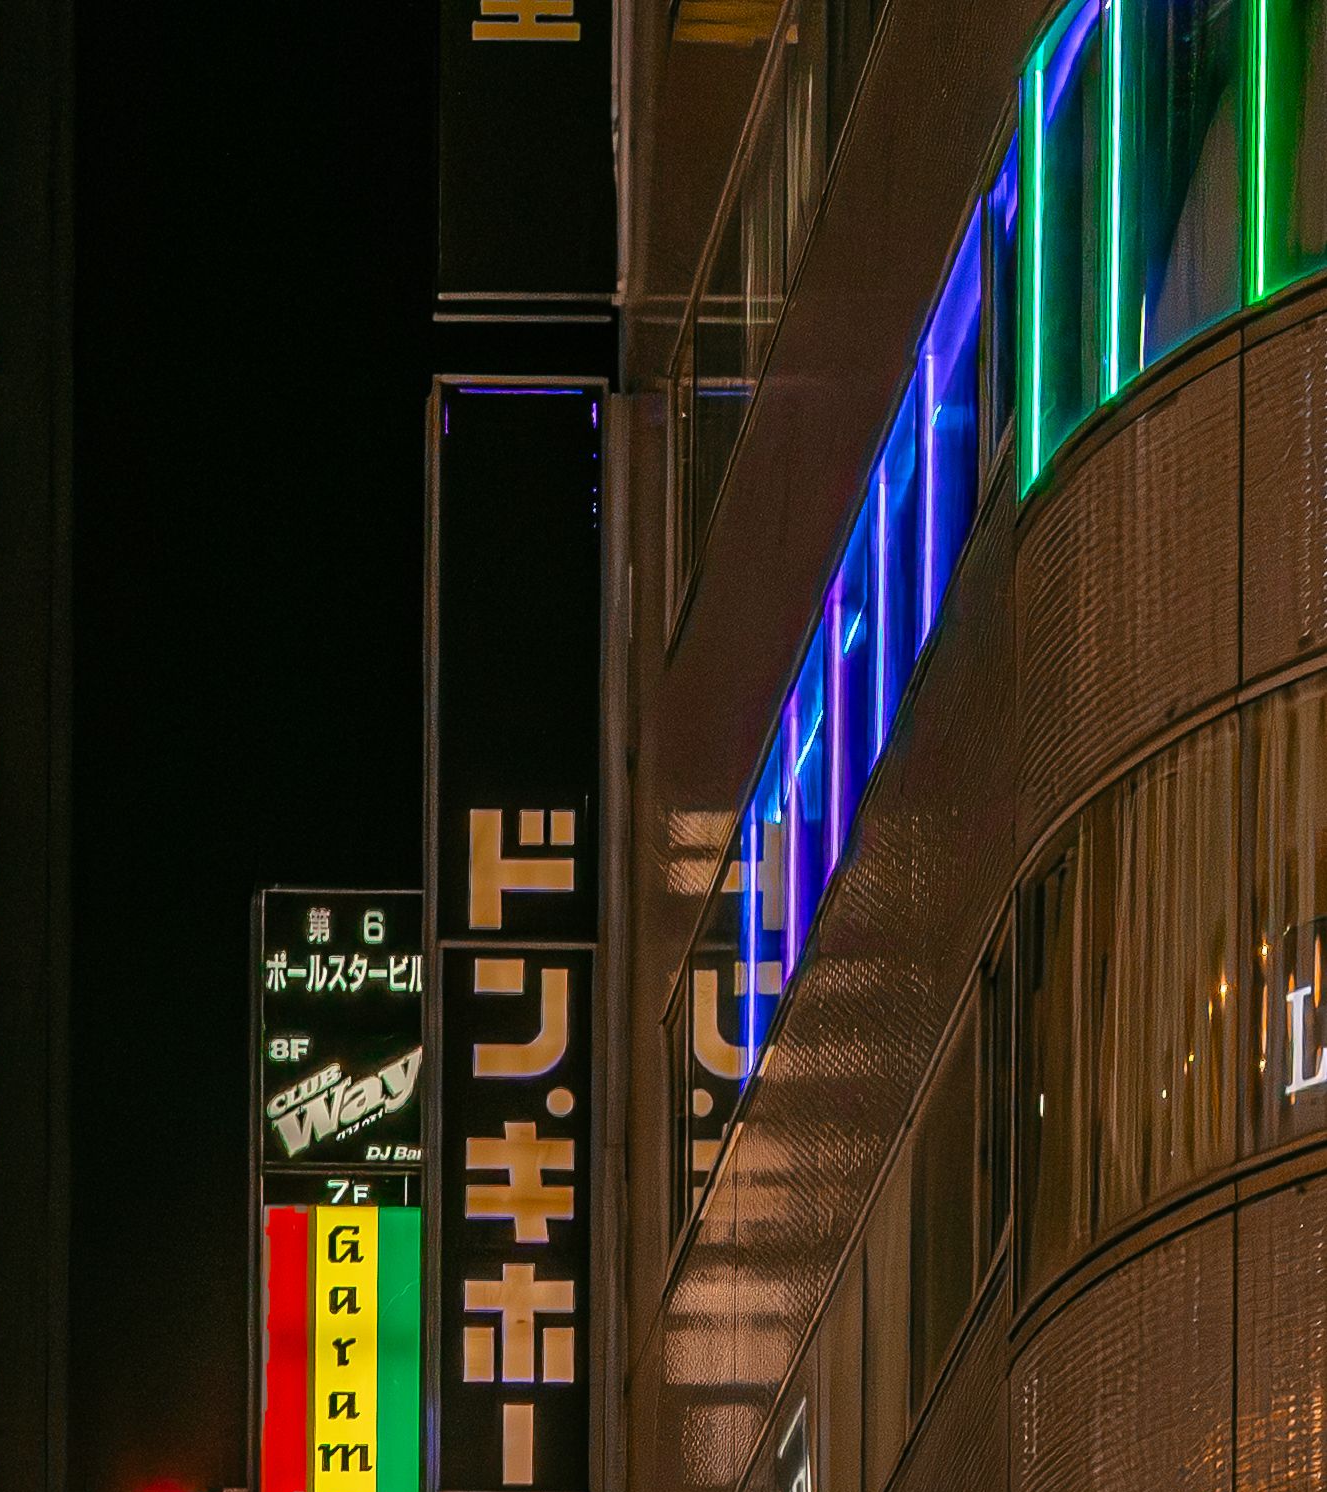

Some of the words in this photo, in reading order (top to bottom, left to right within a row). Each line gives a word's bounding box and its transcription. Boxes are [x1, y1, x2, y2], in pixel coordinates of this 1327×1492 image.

[269, 1038, 310, 1060] 8F
[267, 1063, 340, 1118] CLUB
[272, 1046, 423, 1159] Way
[365, 1145, 390, 1161] DJ
[327, 1180, 370, 1205] 7F
[317, 1223, 373, 1475] Garam
